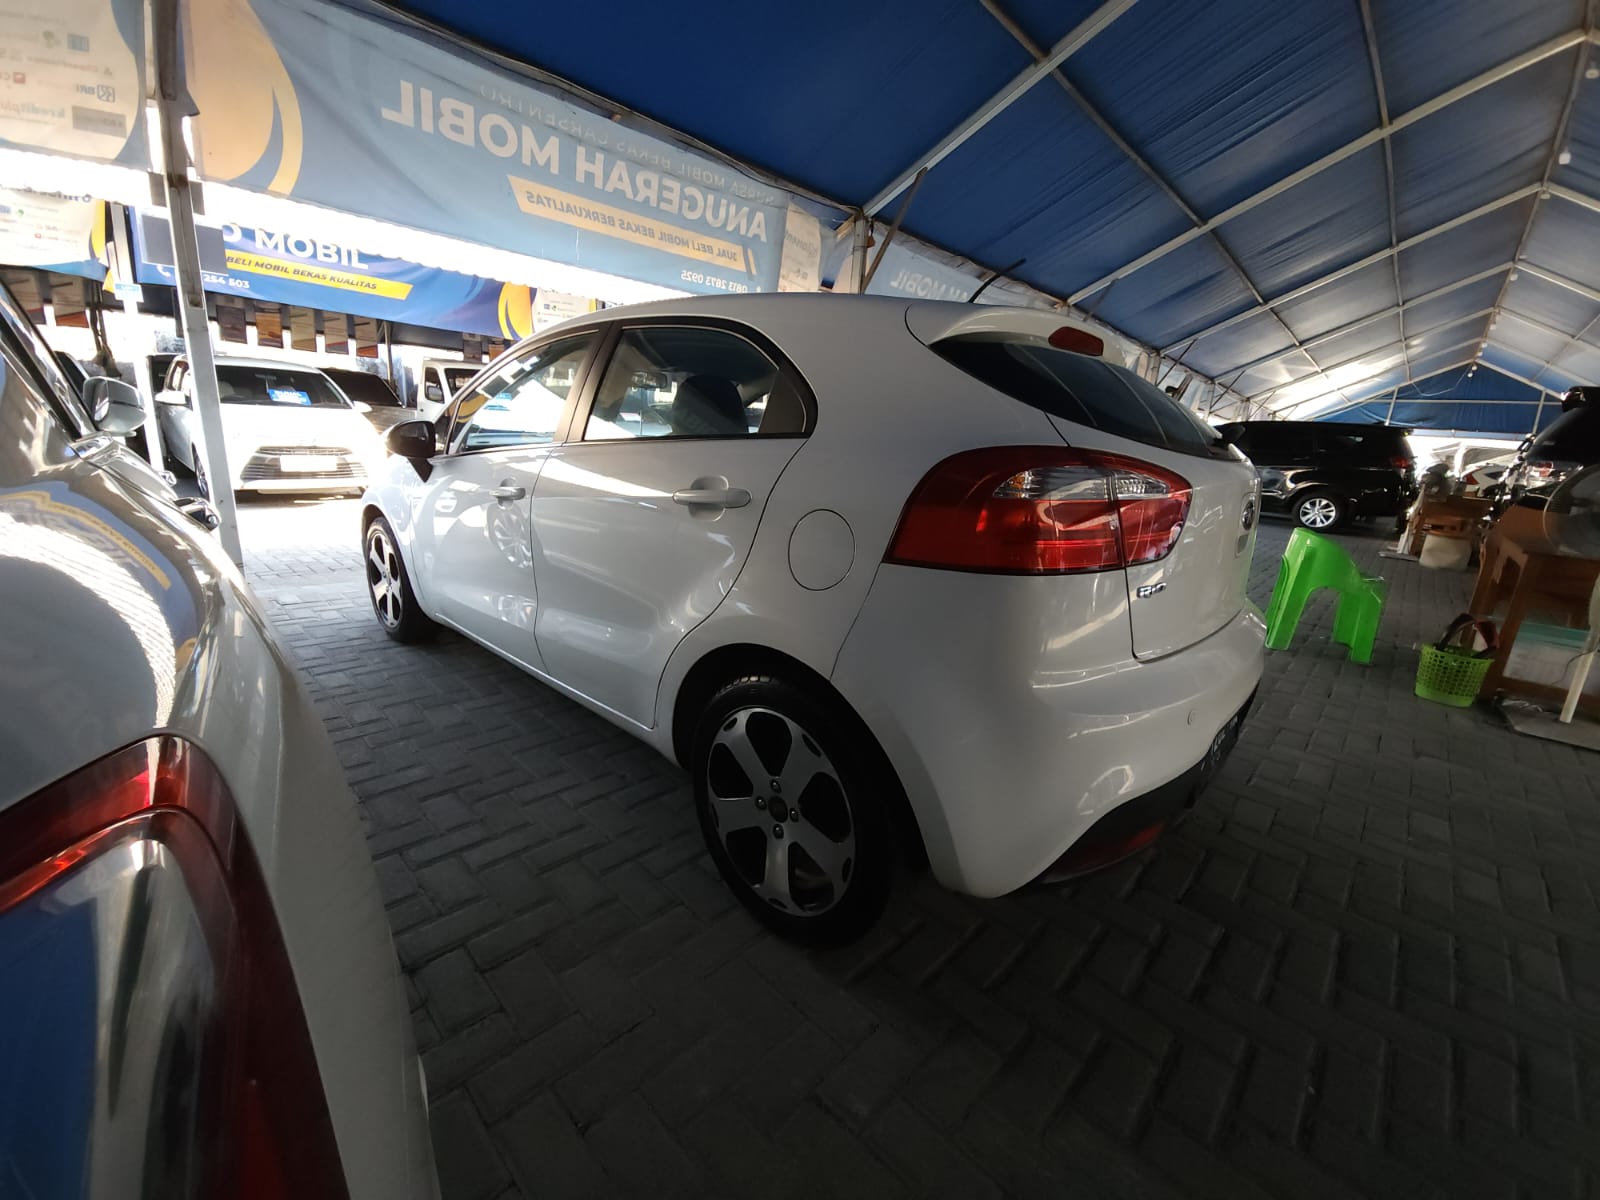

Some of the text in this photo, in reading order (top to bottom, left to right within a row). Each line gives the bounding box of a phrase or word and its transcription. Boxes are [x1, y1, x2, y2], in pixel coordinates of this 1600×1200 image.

[256, 227, 369, 270] MOBIL
[226, 255, 378, 291] BELI MOBIL BEKAS KUALITAS
